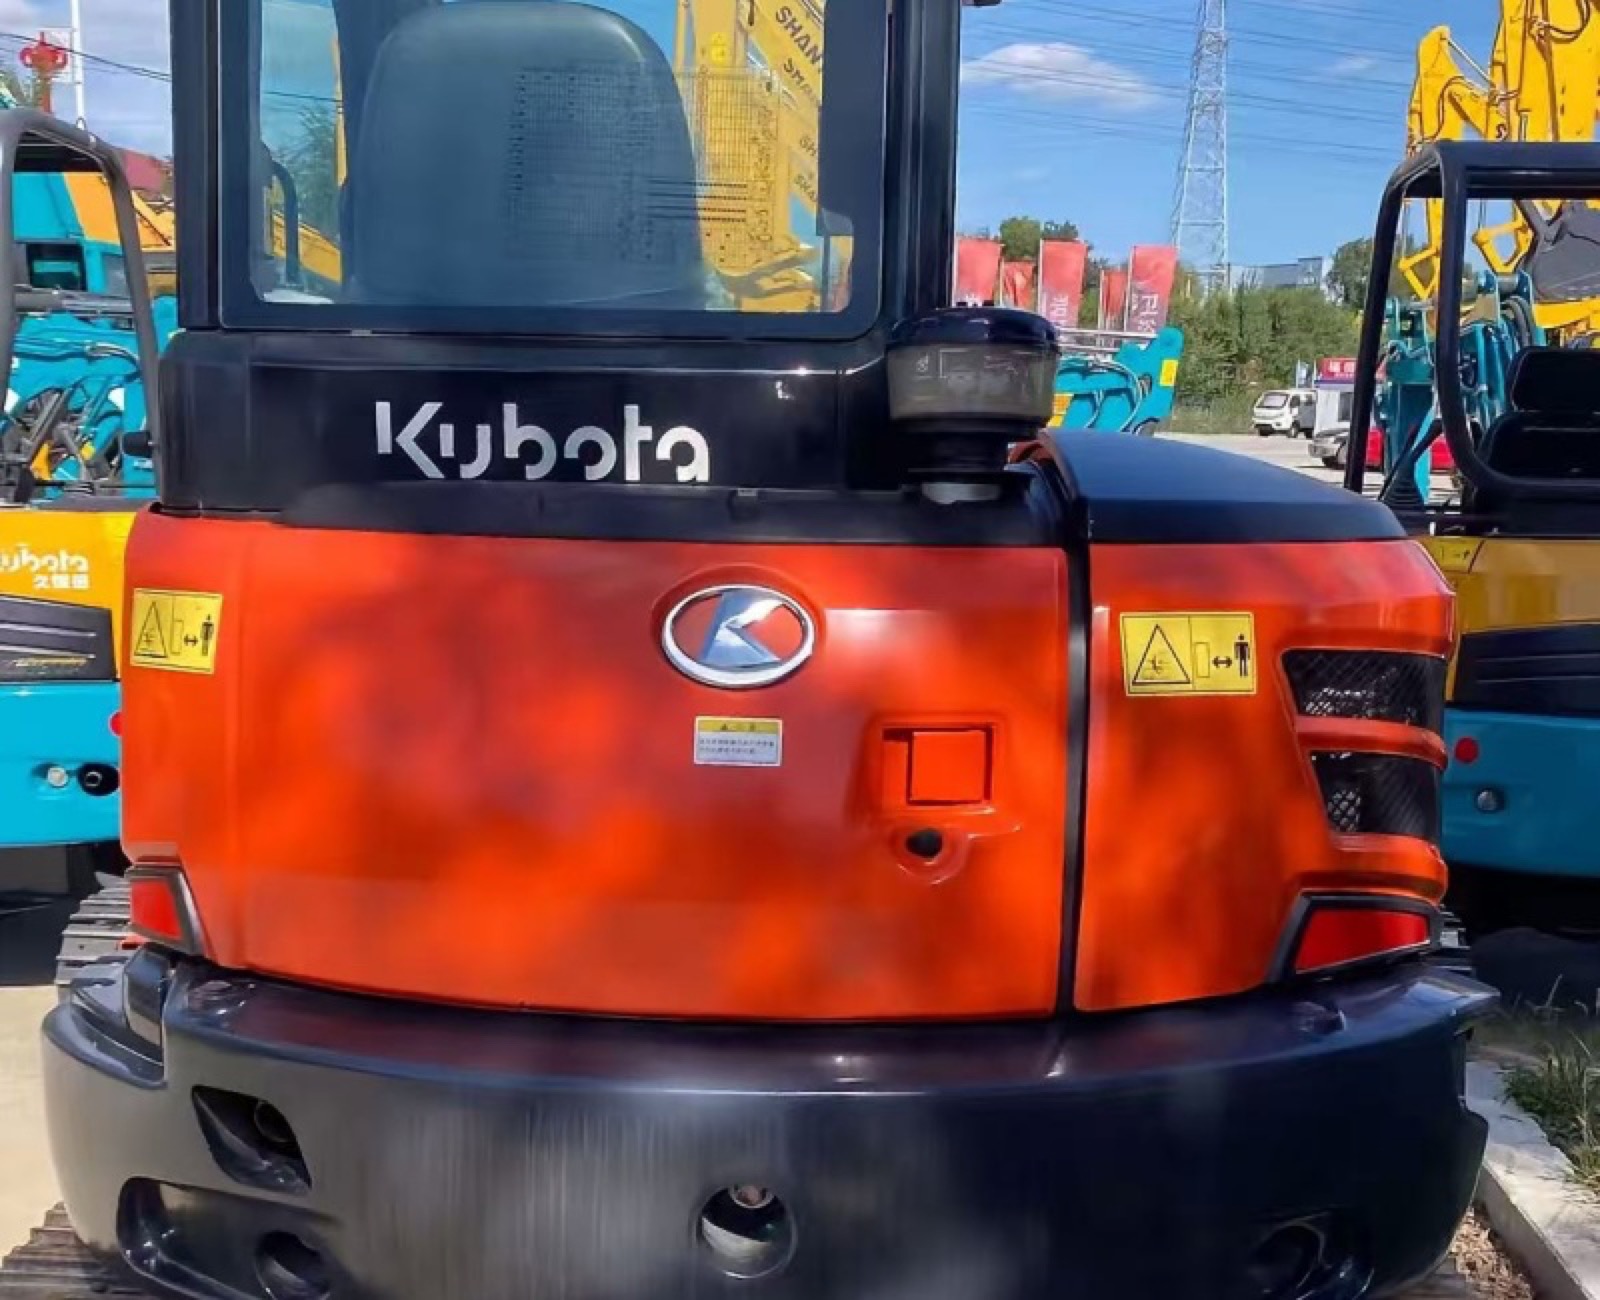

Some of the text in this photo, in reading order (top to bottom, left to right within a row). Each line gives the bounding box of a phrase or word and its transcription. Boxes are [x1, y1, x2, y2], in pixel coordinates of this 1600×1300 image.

[775, 5, 821, 66] SHAN
[375, 401, 711, 483] Kubota
[0, 543, 89, 573] ubota
